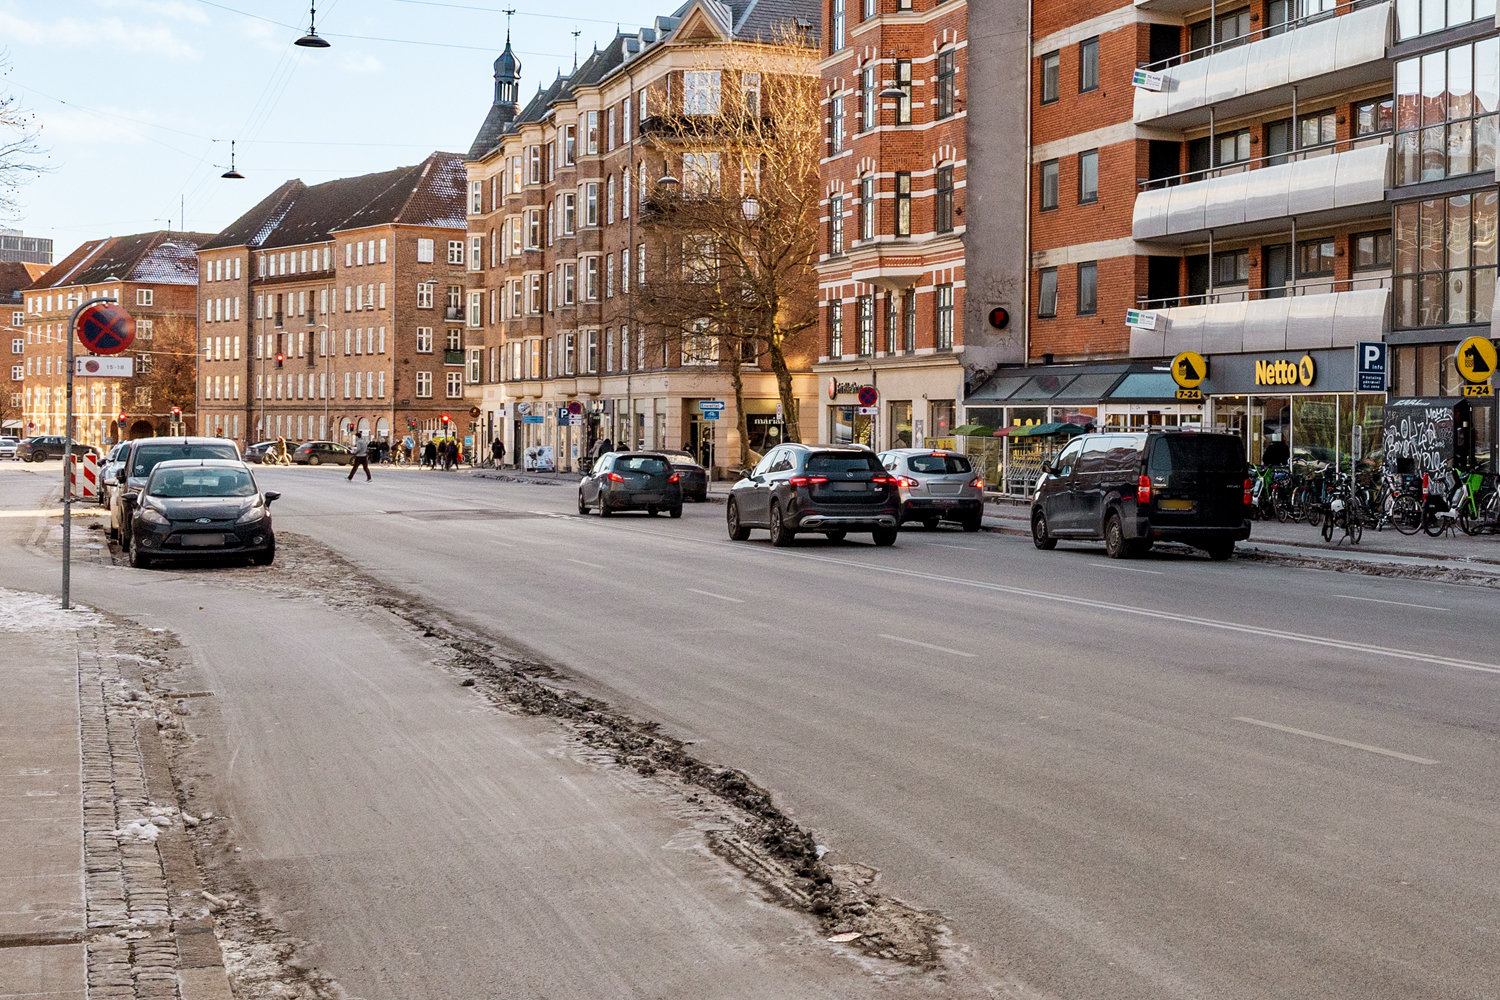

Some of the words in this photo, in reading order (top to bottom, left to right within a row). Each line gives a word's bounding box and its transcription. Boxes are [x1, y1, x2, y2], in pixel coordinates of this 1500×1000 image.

[1364, 345, 1380, 369] P
[1255, 360, 1298, 385] Netto
[1178, 390, 1199, 398] 7-24
[1466, 386, 1489, 396] 7-24
[561, 408, 568, 418] P
